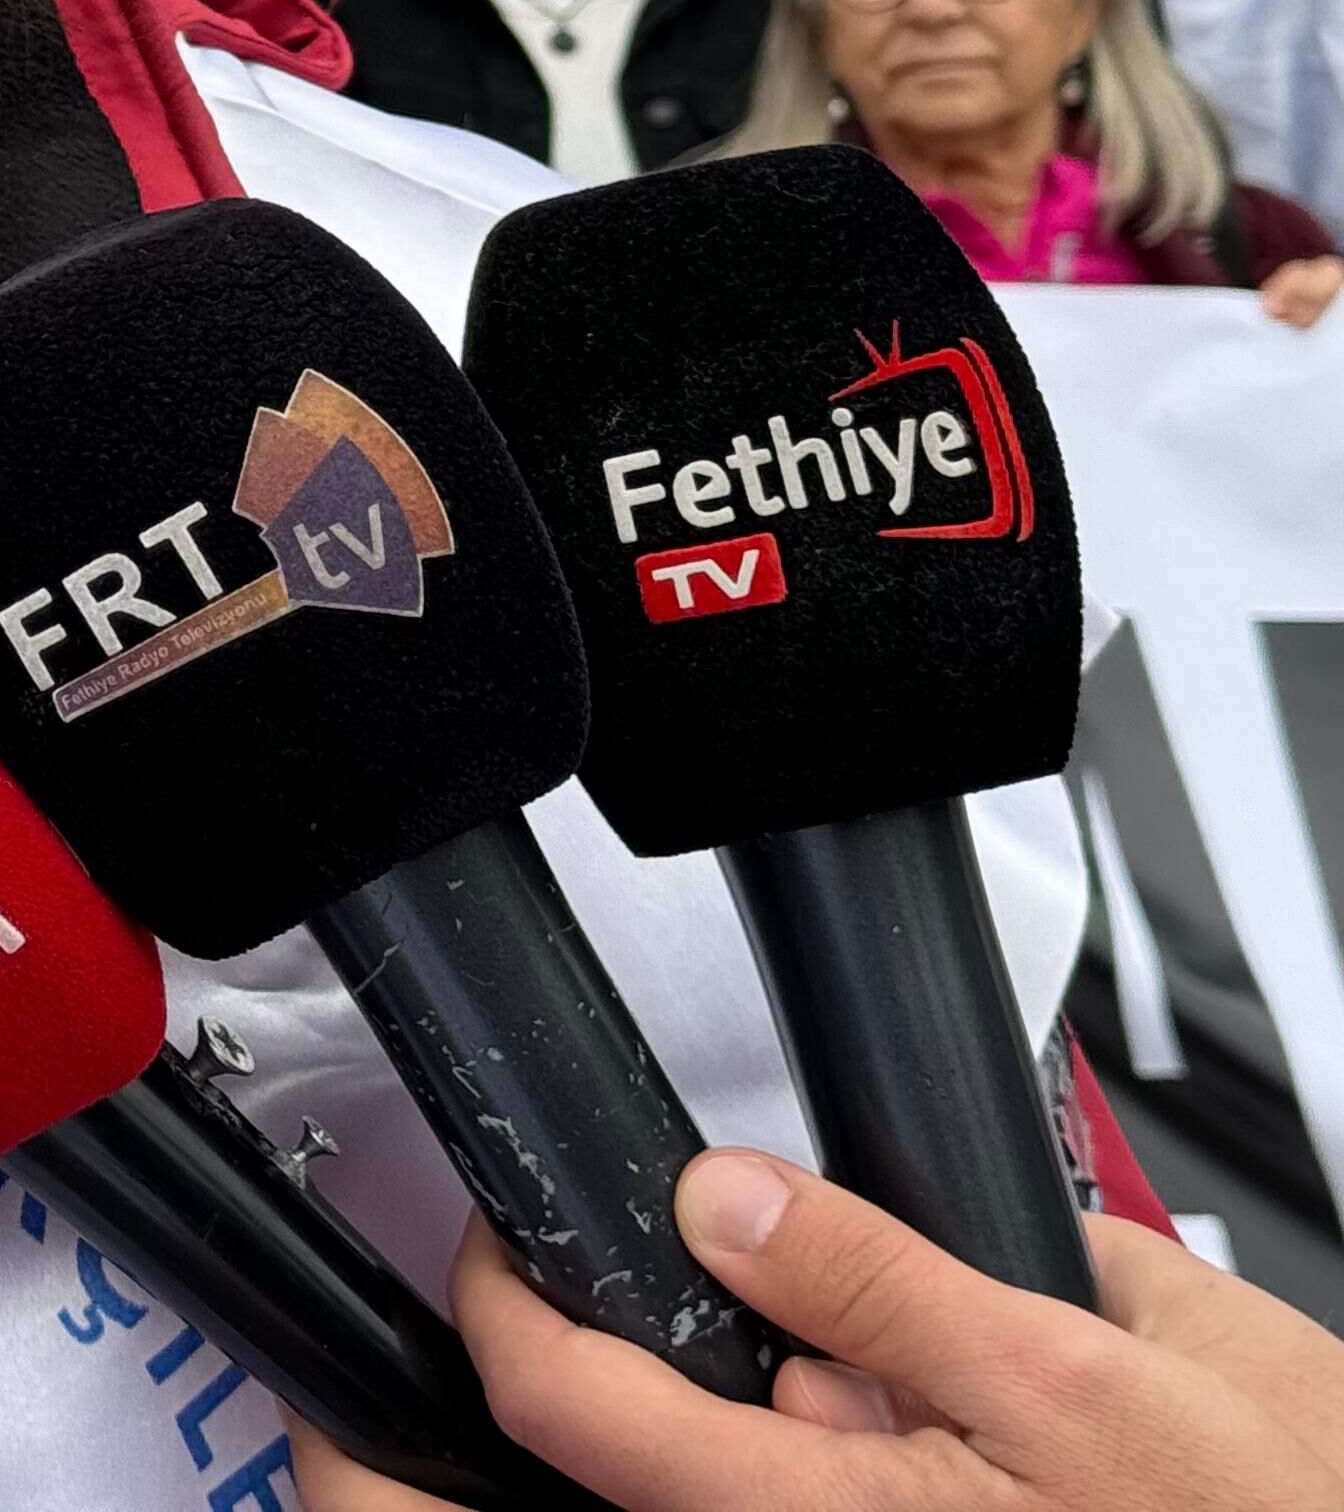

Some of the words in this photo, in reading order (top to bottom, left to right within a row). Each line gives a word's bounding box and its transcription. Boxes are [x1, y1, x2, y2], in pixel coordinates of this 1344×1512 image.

[602, 407, 976, 545] Fethiye
[292, 503, 386, 589] tv
[651, 549, 760, 609] TV
[62, 673, 117, 710] Fethiye
[117, 644, 169, 681] Radyo
[171, 592, 268, 650] Televizyonu
